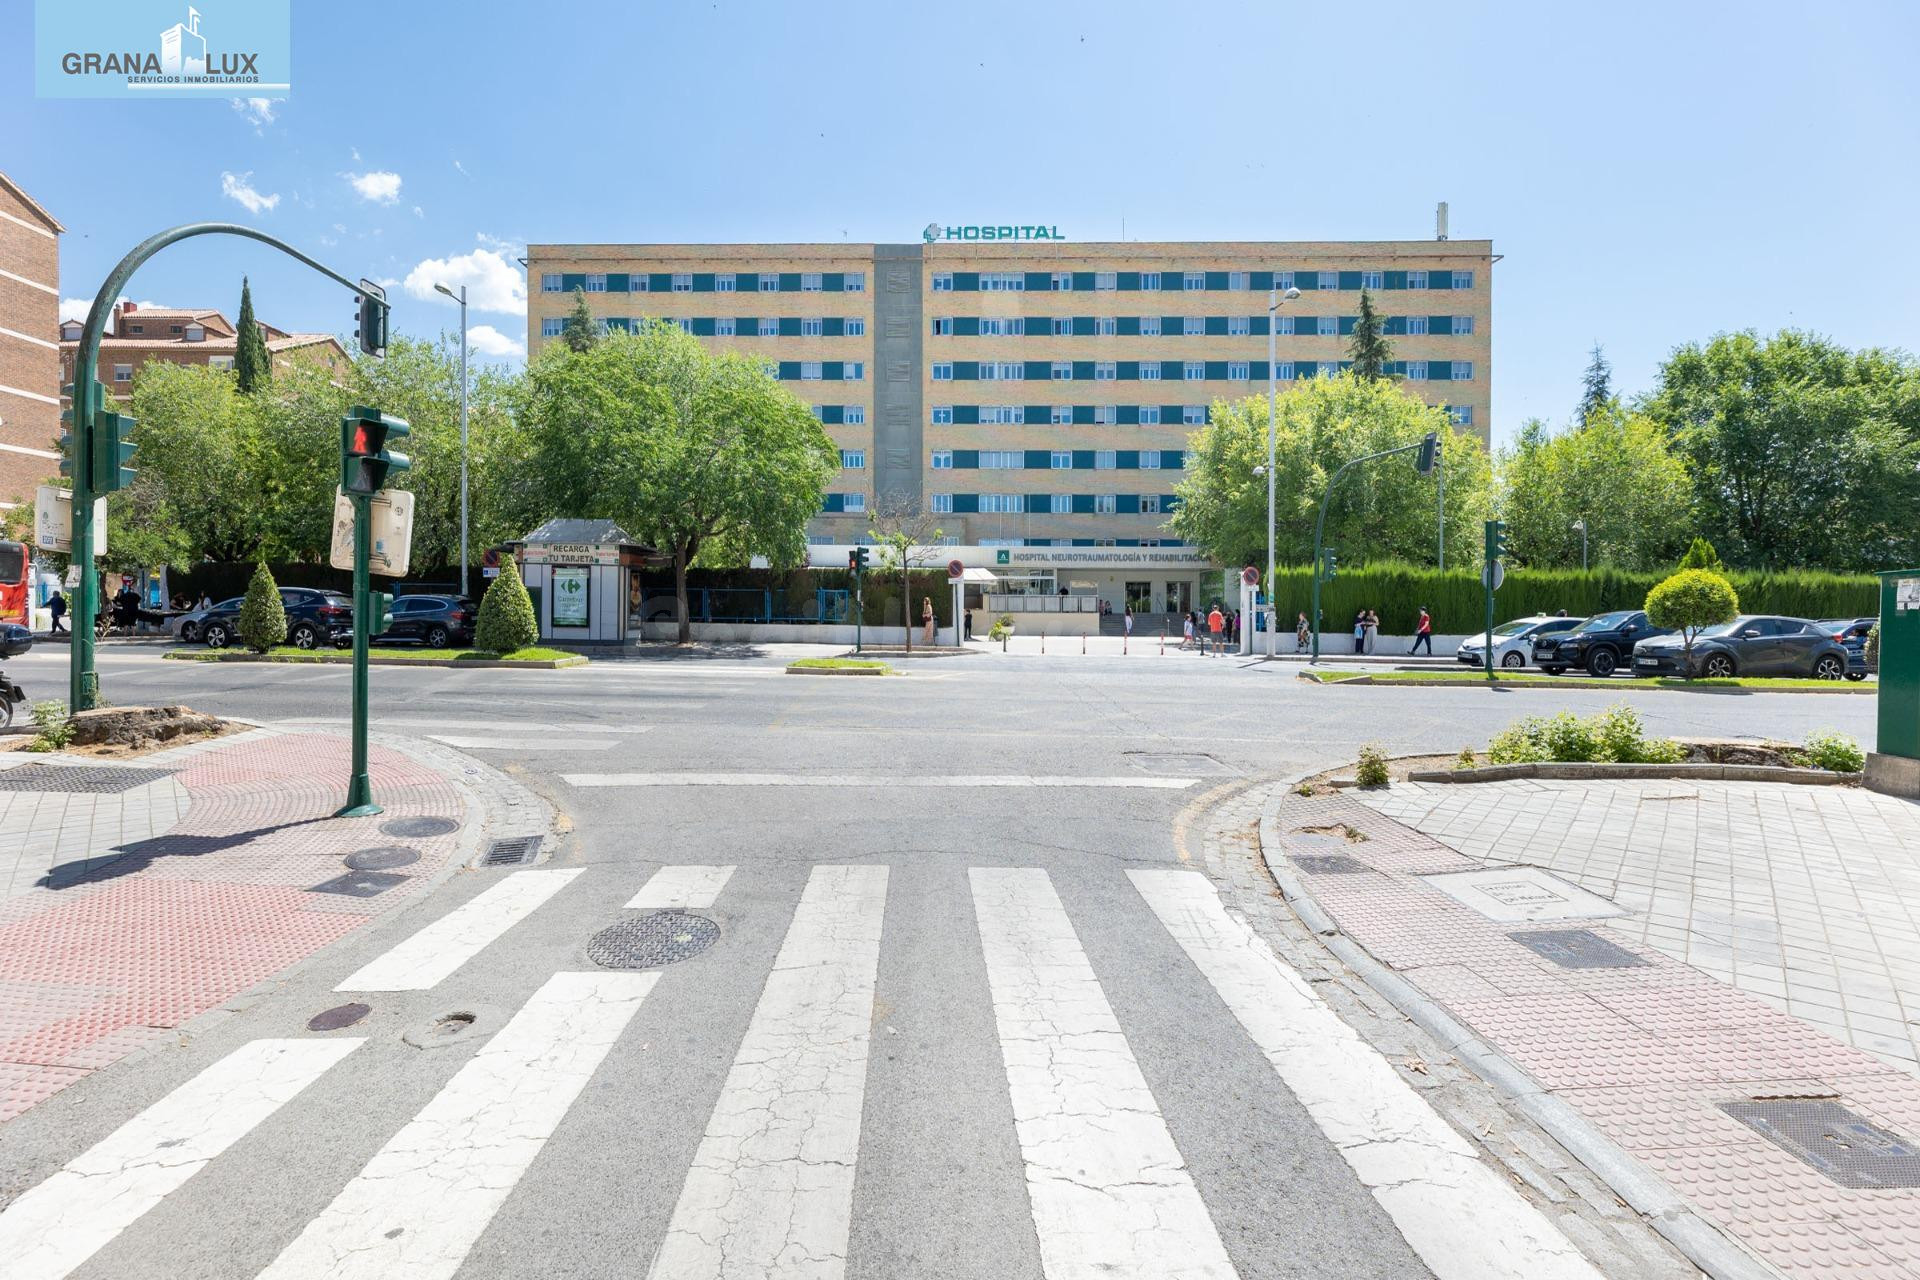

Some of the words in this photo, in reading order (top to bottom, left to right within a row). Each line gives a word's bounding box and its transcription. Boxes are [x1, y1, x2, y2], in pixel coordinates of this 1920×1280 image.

[946, 226, 1066, 240] HOSPITAL
[553, 545, 589, 553] RECARGA
[561, 555, 594, 563] TARJETA
[1014, 553, 1050, 561] HOSPITAL
[1052, 552, 1140, 562] NEUROTRAUMATOLOGÍA
[1142, 553, 1148, 561] Y
